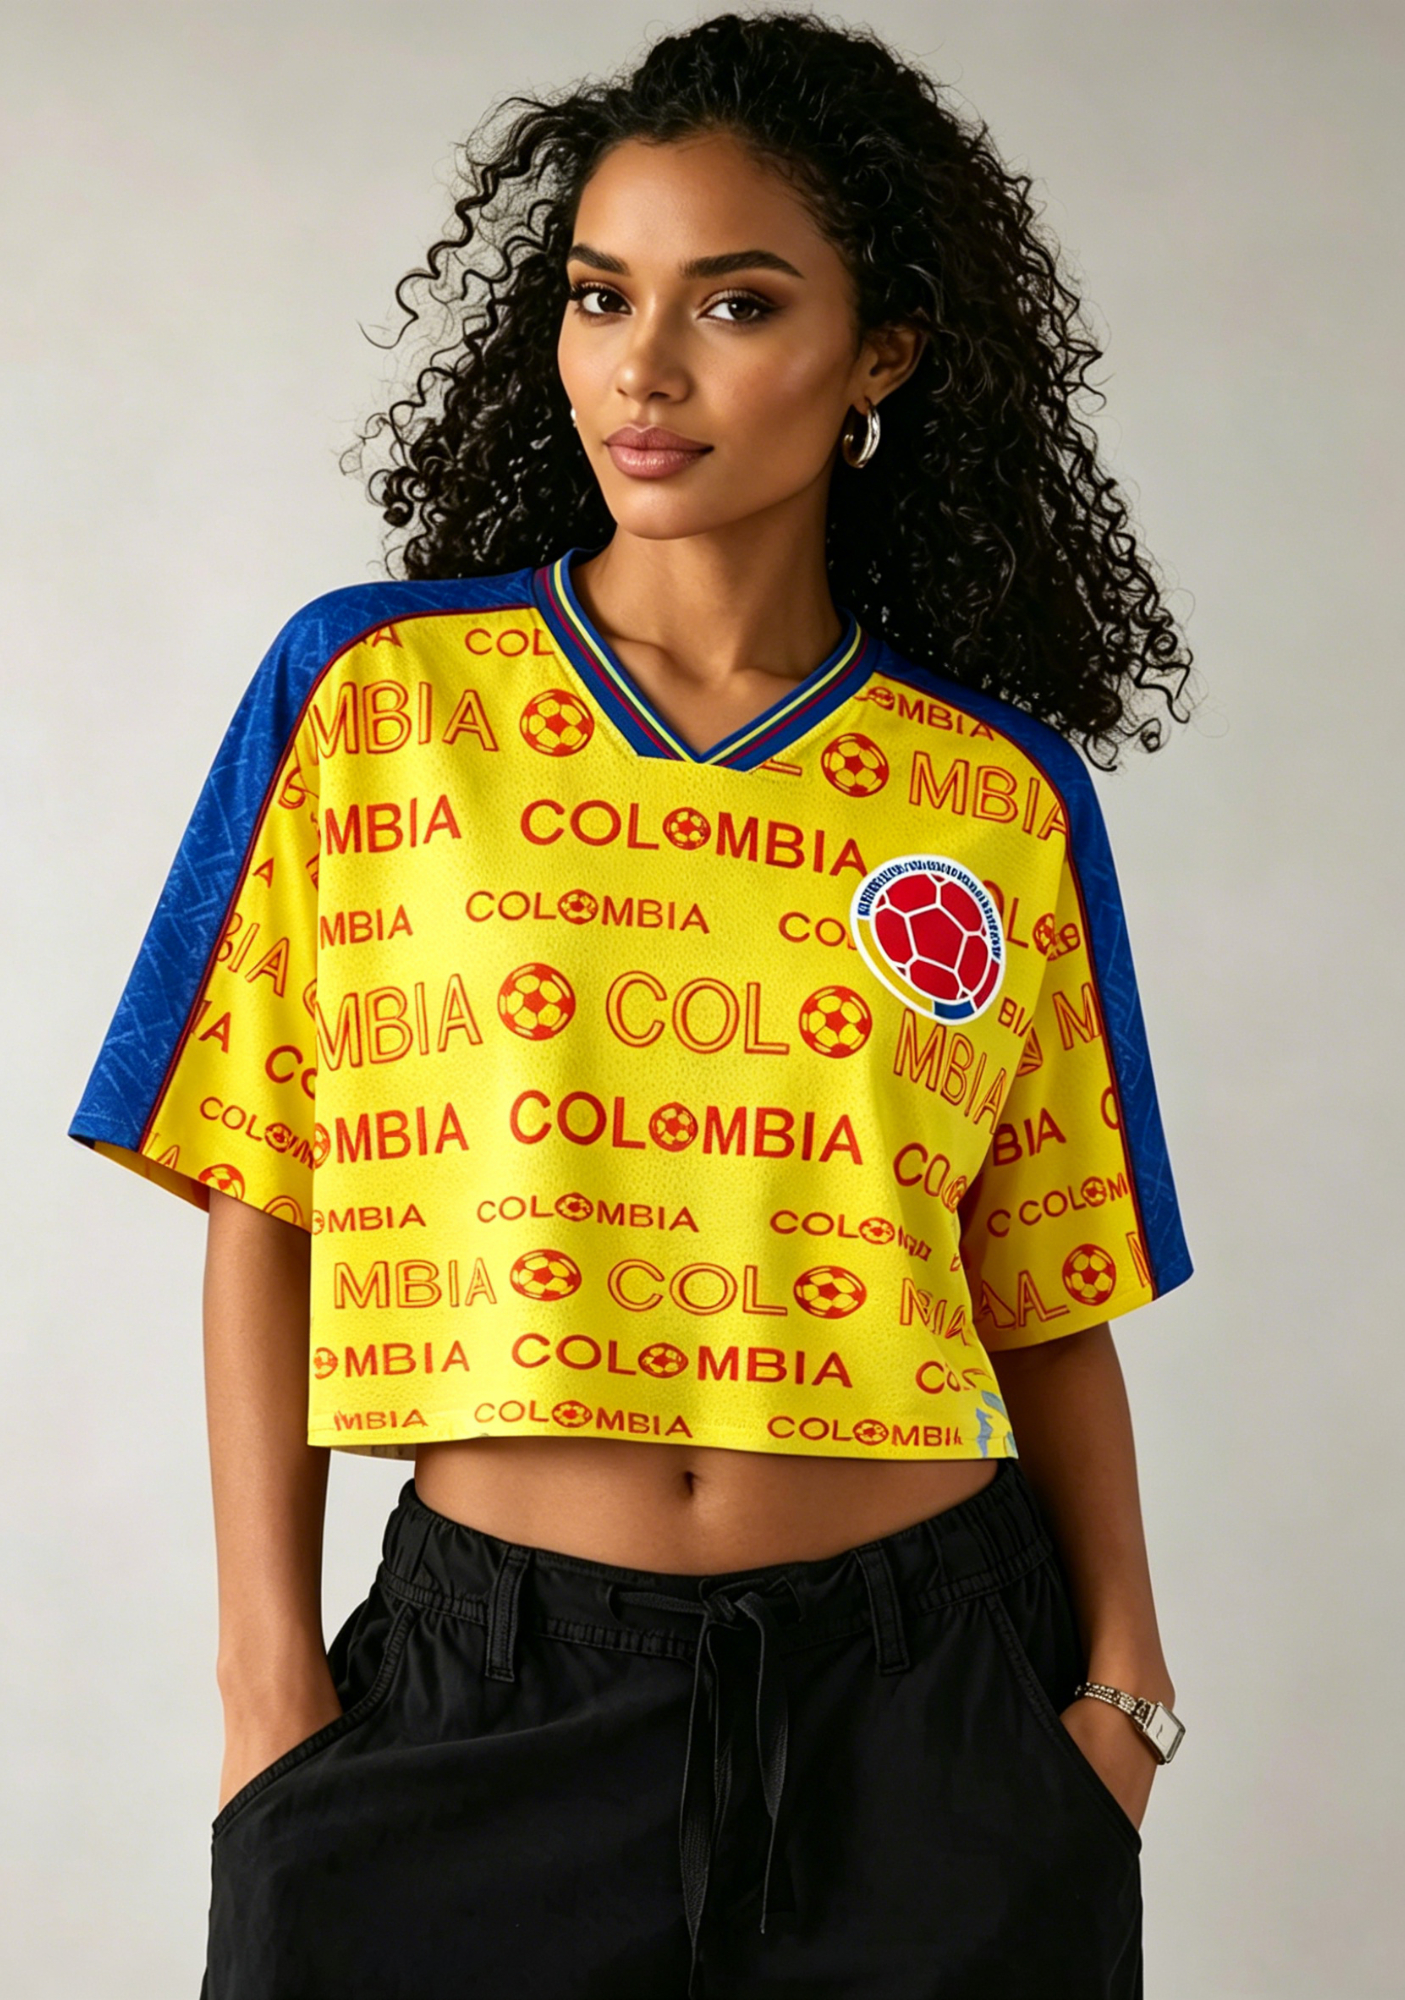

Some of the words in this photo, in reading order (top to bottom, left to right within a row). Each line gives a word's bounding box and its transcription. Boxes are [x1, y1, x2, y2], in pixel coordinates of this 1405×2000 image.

[325, 794, 462, 856] MBIA
[320, 904, 413, 949] MBIA
[779, 911, 858, 950] CO
